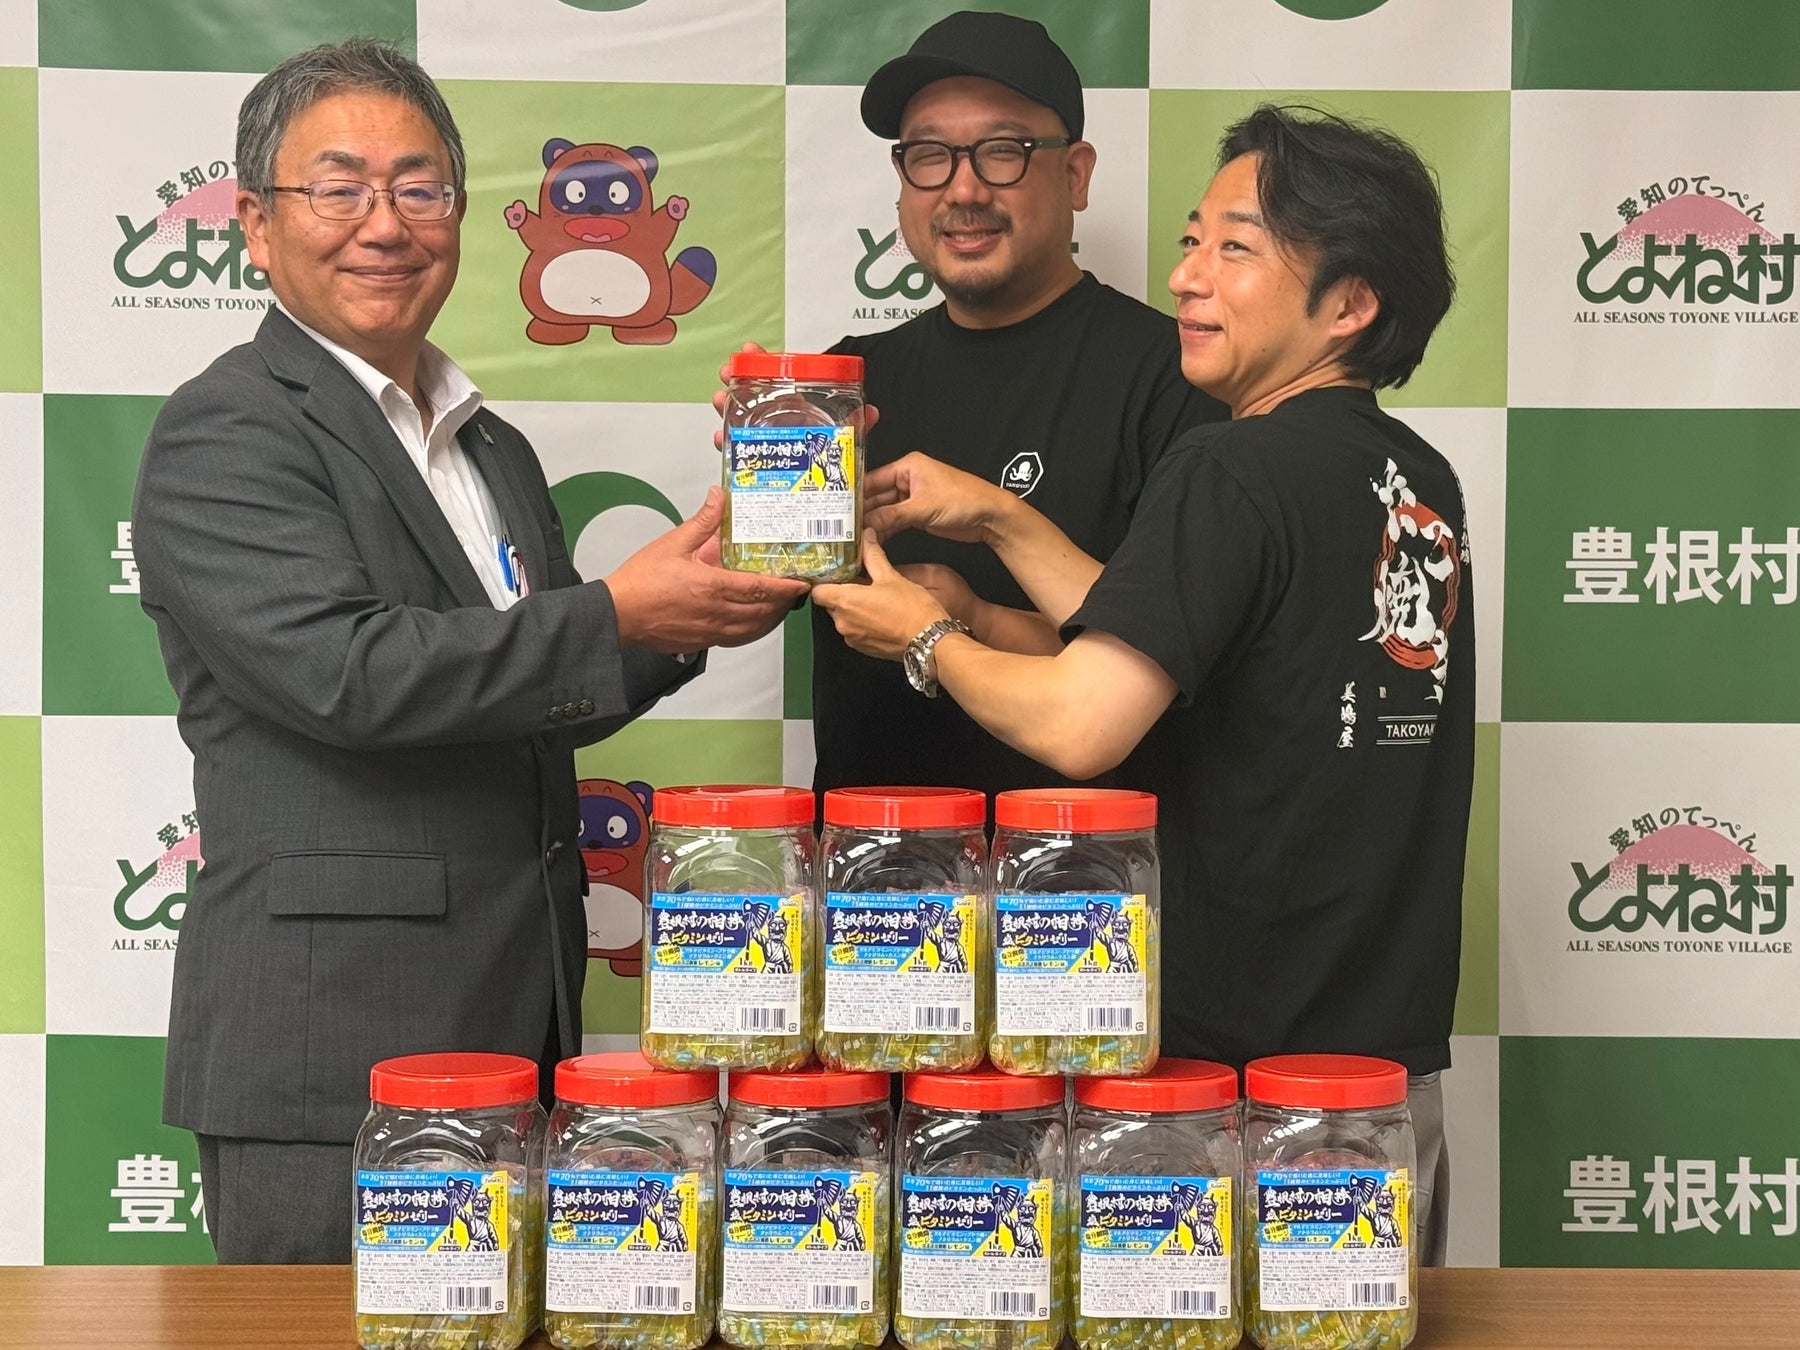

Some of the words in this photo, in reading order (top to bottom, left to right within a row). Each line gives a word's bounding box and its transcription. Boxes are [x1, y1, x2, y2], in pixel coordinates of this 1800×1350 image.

[156, 160, 237, 208] 愛知の
[1617, 175, 1765, 224] 愛知のてっぺん
[1576, 232, 1800, 305] とよね村
[111, 296, 141, 307] ALL
[145, 296, 210, 309] SEASONS
[852, 307, 880, 319] ALL
[1573, 311, 1600, 323] ALL
[1603, 311, 1665, 324] SEASONS
[1669, 311, 1730, 324] TOYONE
[1735, 311, 1799, 324] VILLAGE
[1563, 526, 1800, 605] 豊根村
[1608, 806, 1758, 854] 愛知のてっぺん
[1568, 862, 1794, 935] とよね村
[112, 939, 140, 950] ALL
[1566, 940, 1593, 952] ALL
[1597, 940, 1660, 953] SEASONS
[1664, 940, 1724, 953] TOYONE
[1728, 940, 1793, 954] VILLAGE
[108, 1154, 209, 1234] 豊
[1562, 1155, 1800, 1236] 豊根村
